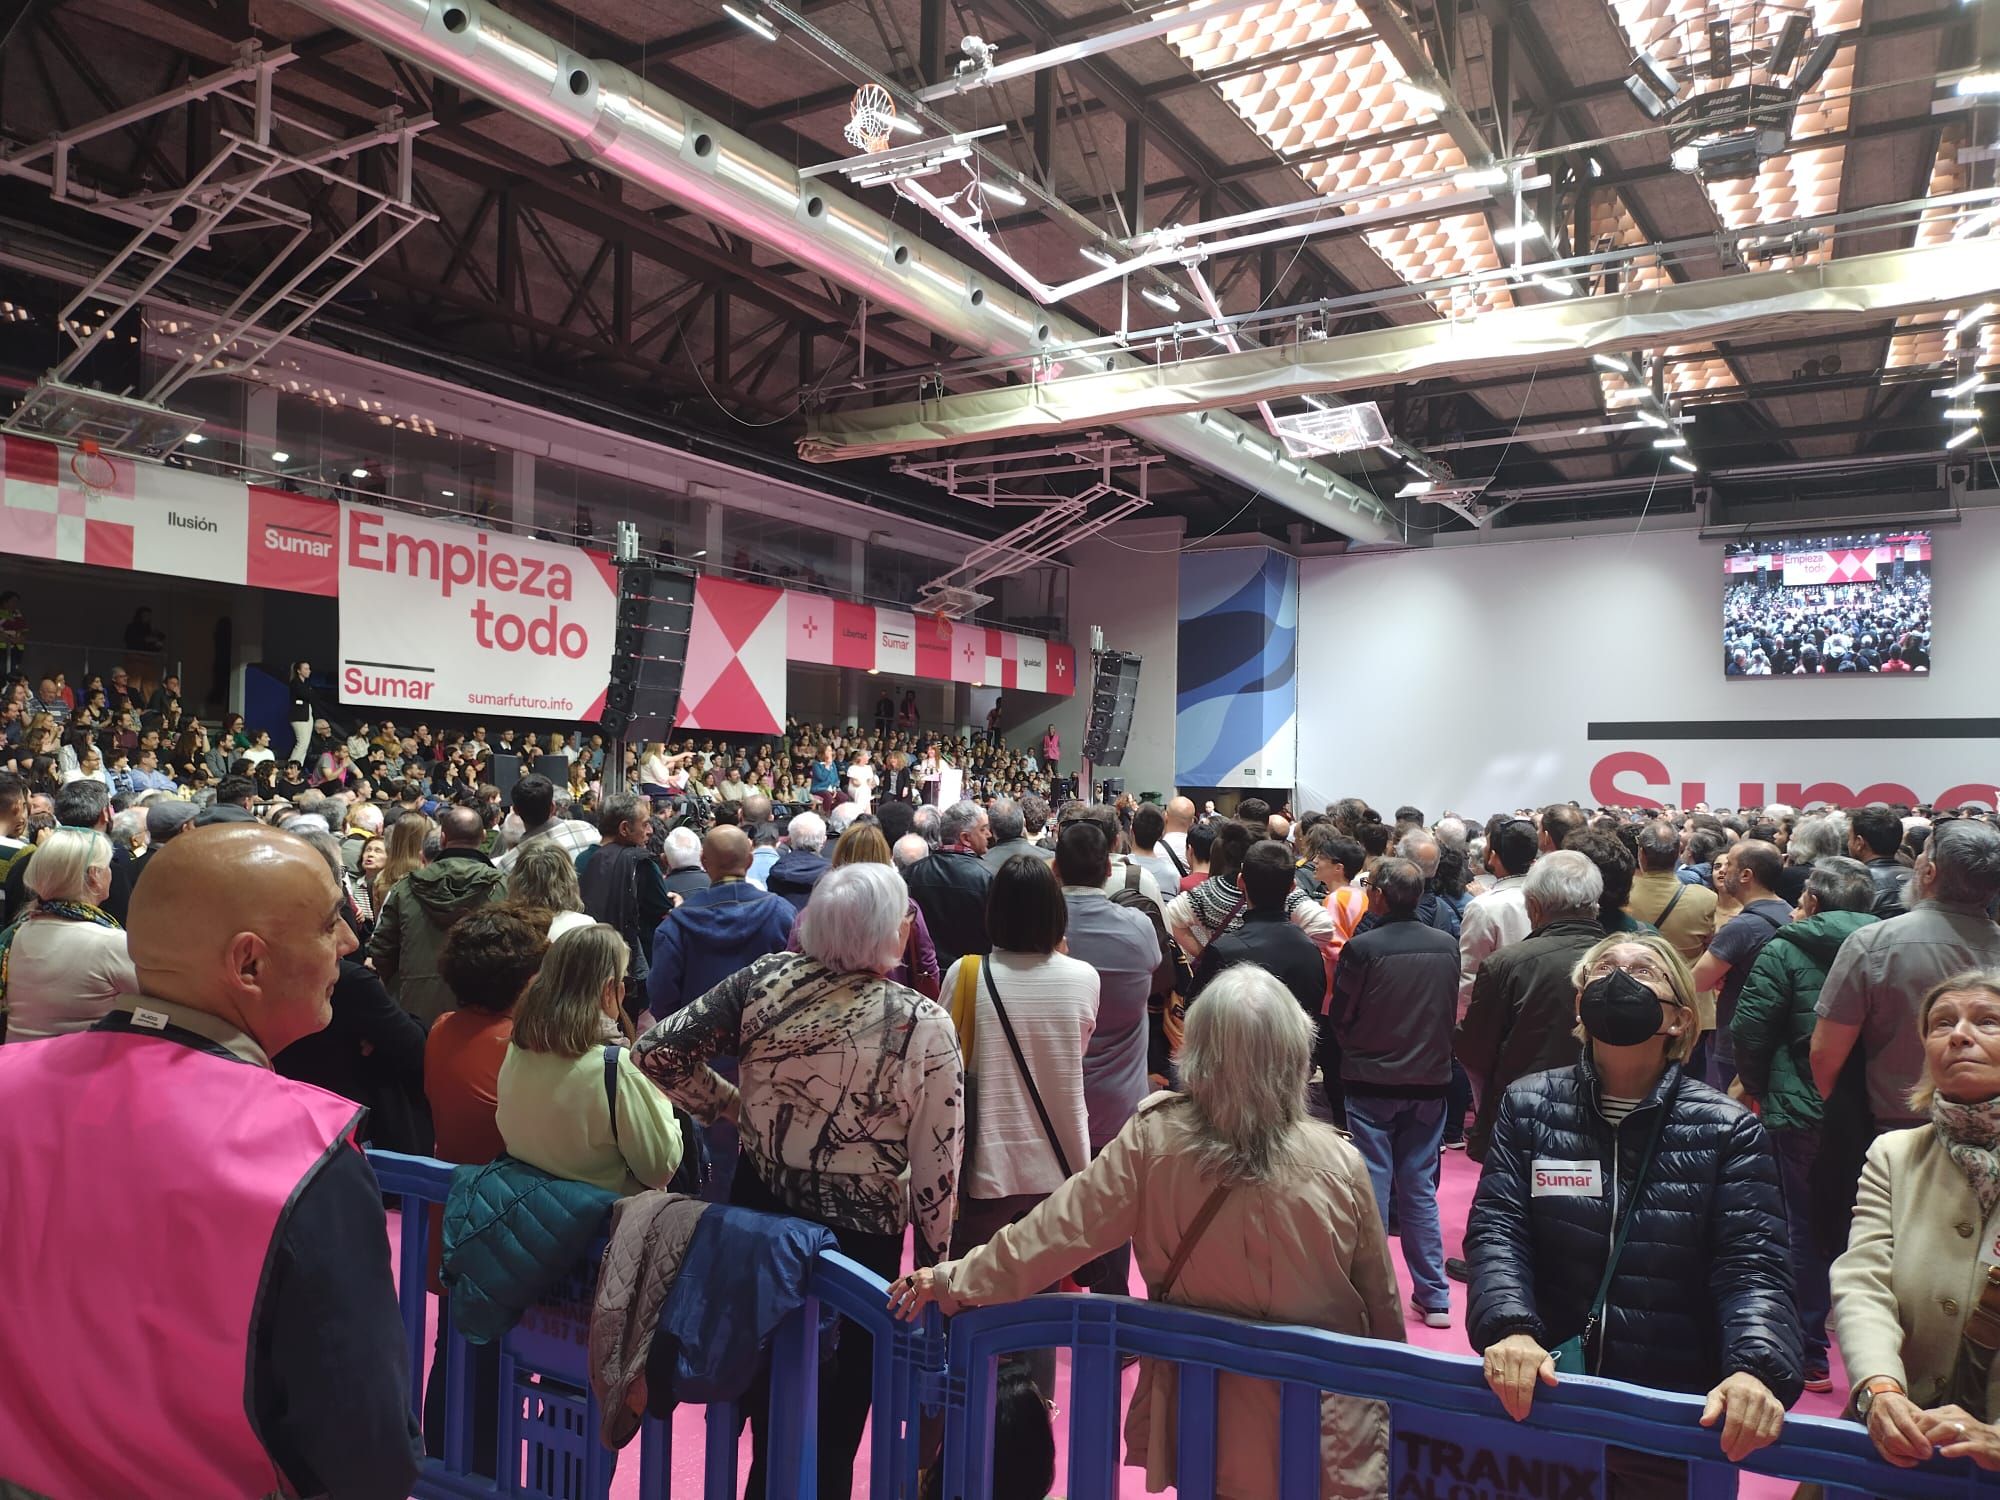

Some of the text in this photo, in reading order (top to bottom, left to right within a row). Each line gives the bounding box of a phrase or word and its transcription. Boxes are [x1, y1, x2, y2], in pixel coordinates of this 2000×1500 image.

[168, 511, 218, 533] Ilusión
[265, 528, 333, 558] Sumar
[348, 509, 572, 601] Empieza
[470, 599, 588, 659] todo
[882, 635, 909, 650] Sumar
[344, 668, 435, 700] Sumar
[468, 693, 573, 711] sumarfuturo.info
[1536, 1172, 1592, 1187] Sumar
[1396, 1430, 1601, 1500] TRANIX
